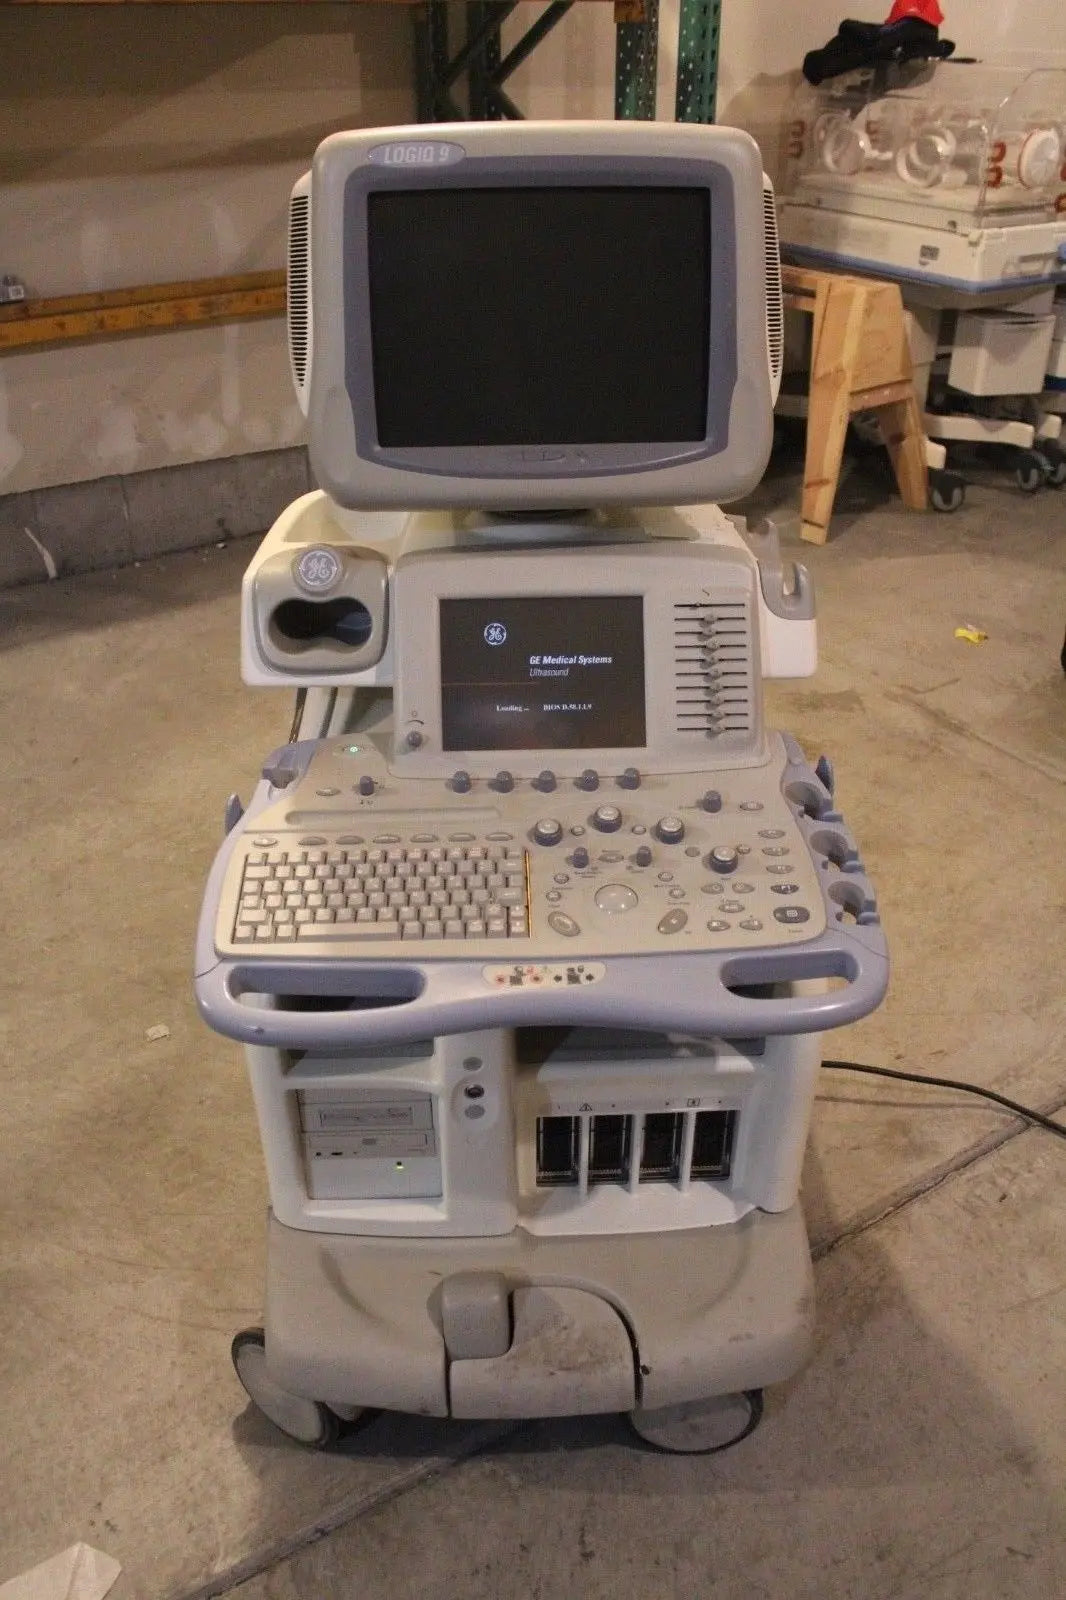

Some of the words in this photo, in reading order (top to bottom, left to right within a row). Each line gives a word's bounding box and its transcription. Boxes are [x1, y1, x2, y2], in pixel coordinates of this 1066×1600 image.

[439, 145, 449, 162] 9
[529, 655, 541, 665] GE
[542, 655, 577, 665] Medical
[578, 655, 613, 666] Systems
[529, 668, 570, 677] Ultrasound
